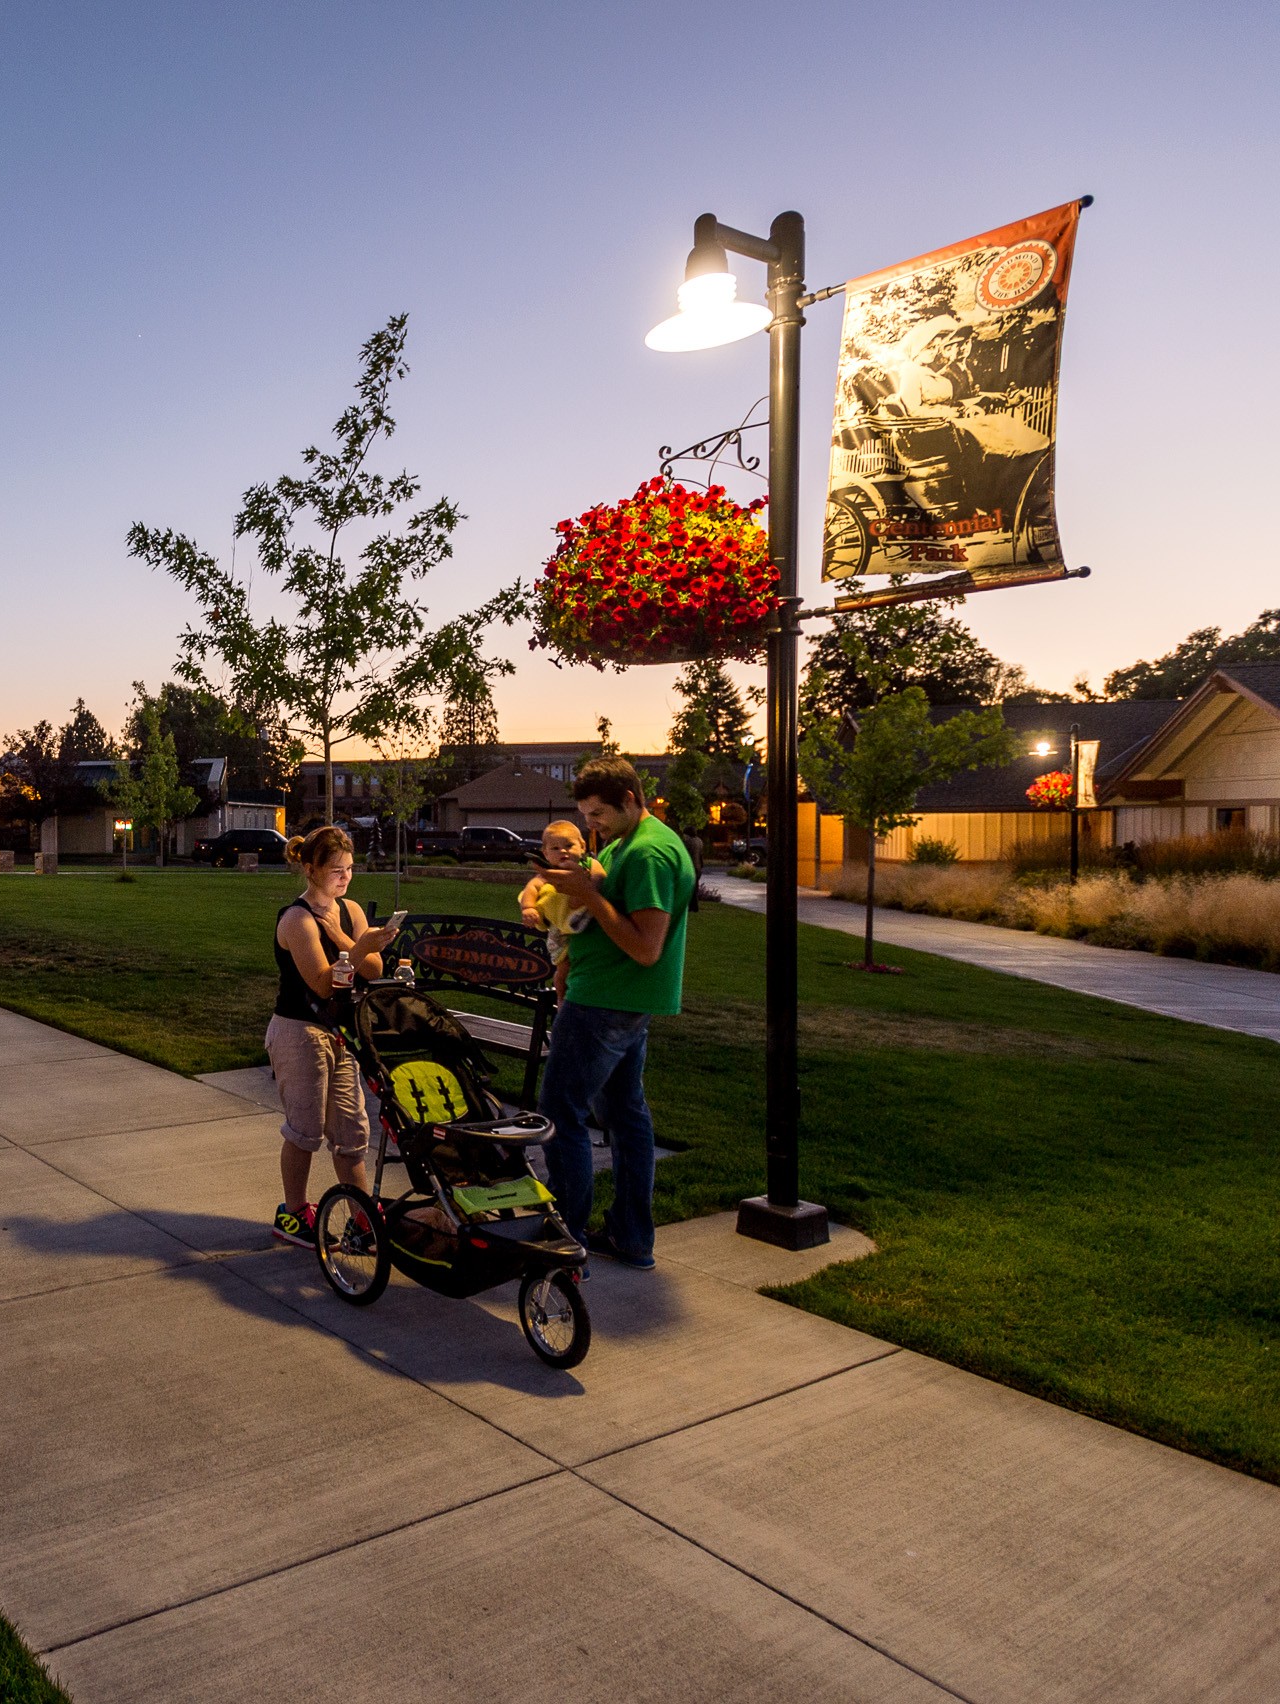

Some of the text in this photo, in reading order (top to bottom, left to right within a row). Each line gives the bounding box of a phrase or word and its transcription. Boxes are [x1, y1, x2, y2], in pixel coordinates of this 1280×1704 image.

[995, 254, 1039, 275] REDMOND
[993, 279, 1034, 298] THE HUB
[870, 508, 1003, 536] Centennial
[908, 543, 969, 562] Park
[423, 943, 539, 973] REDMOND
